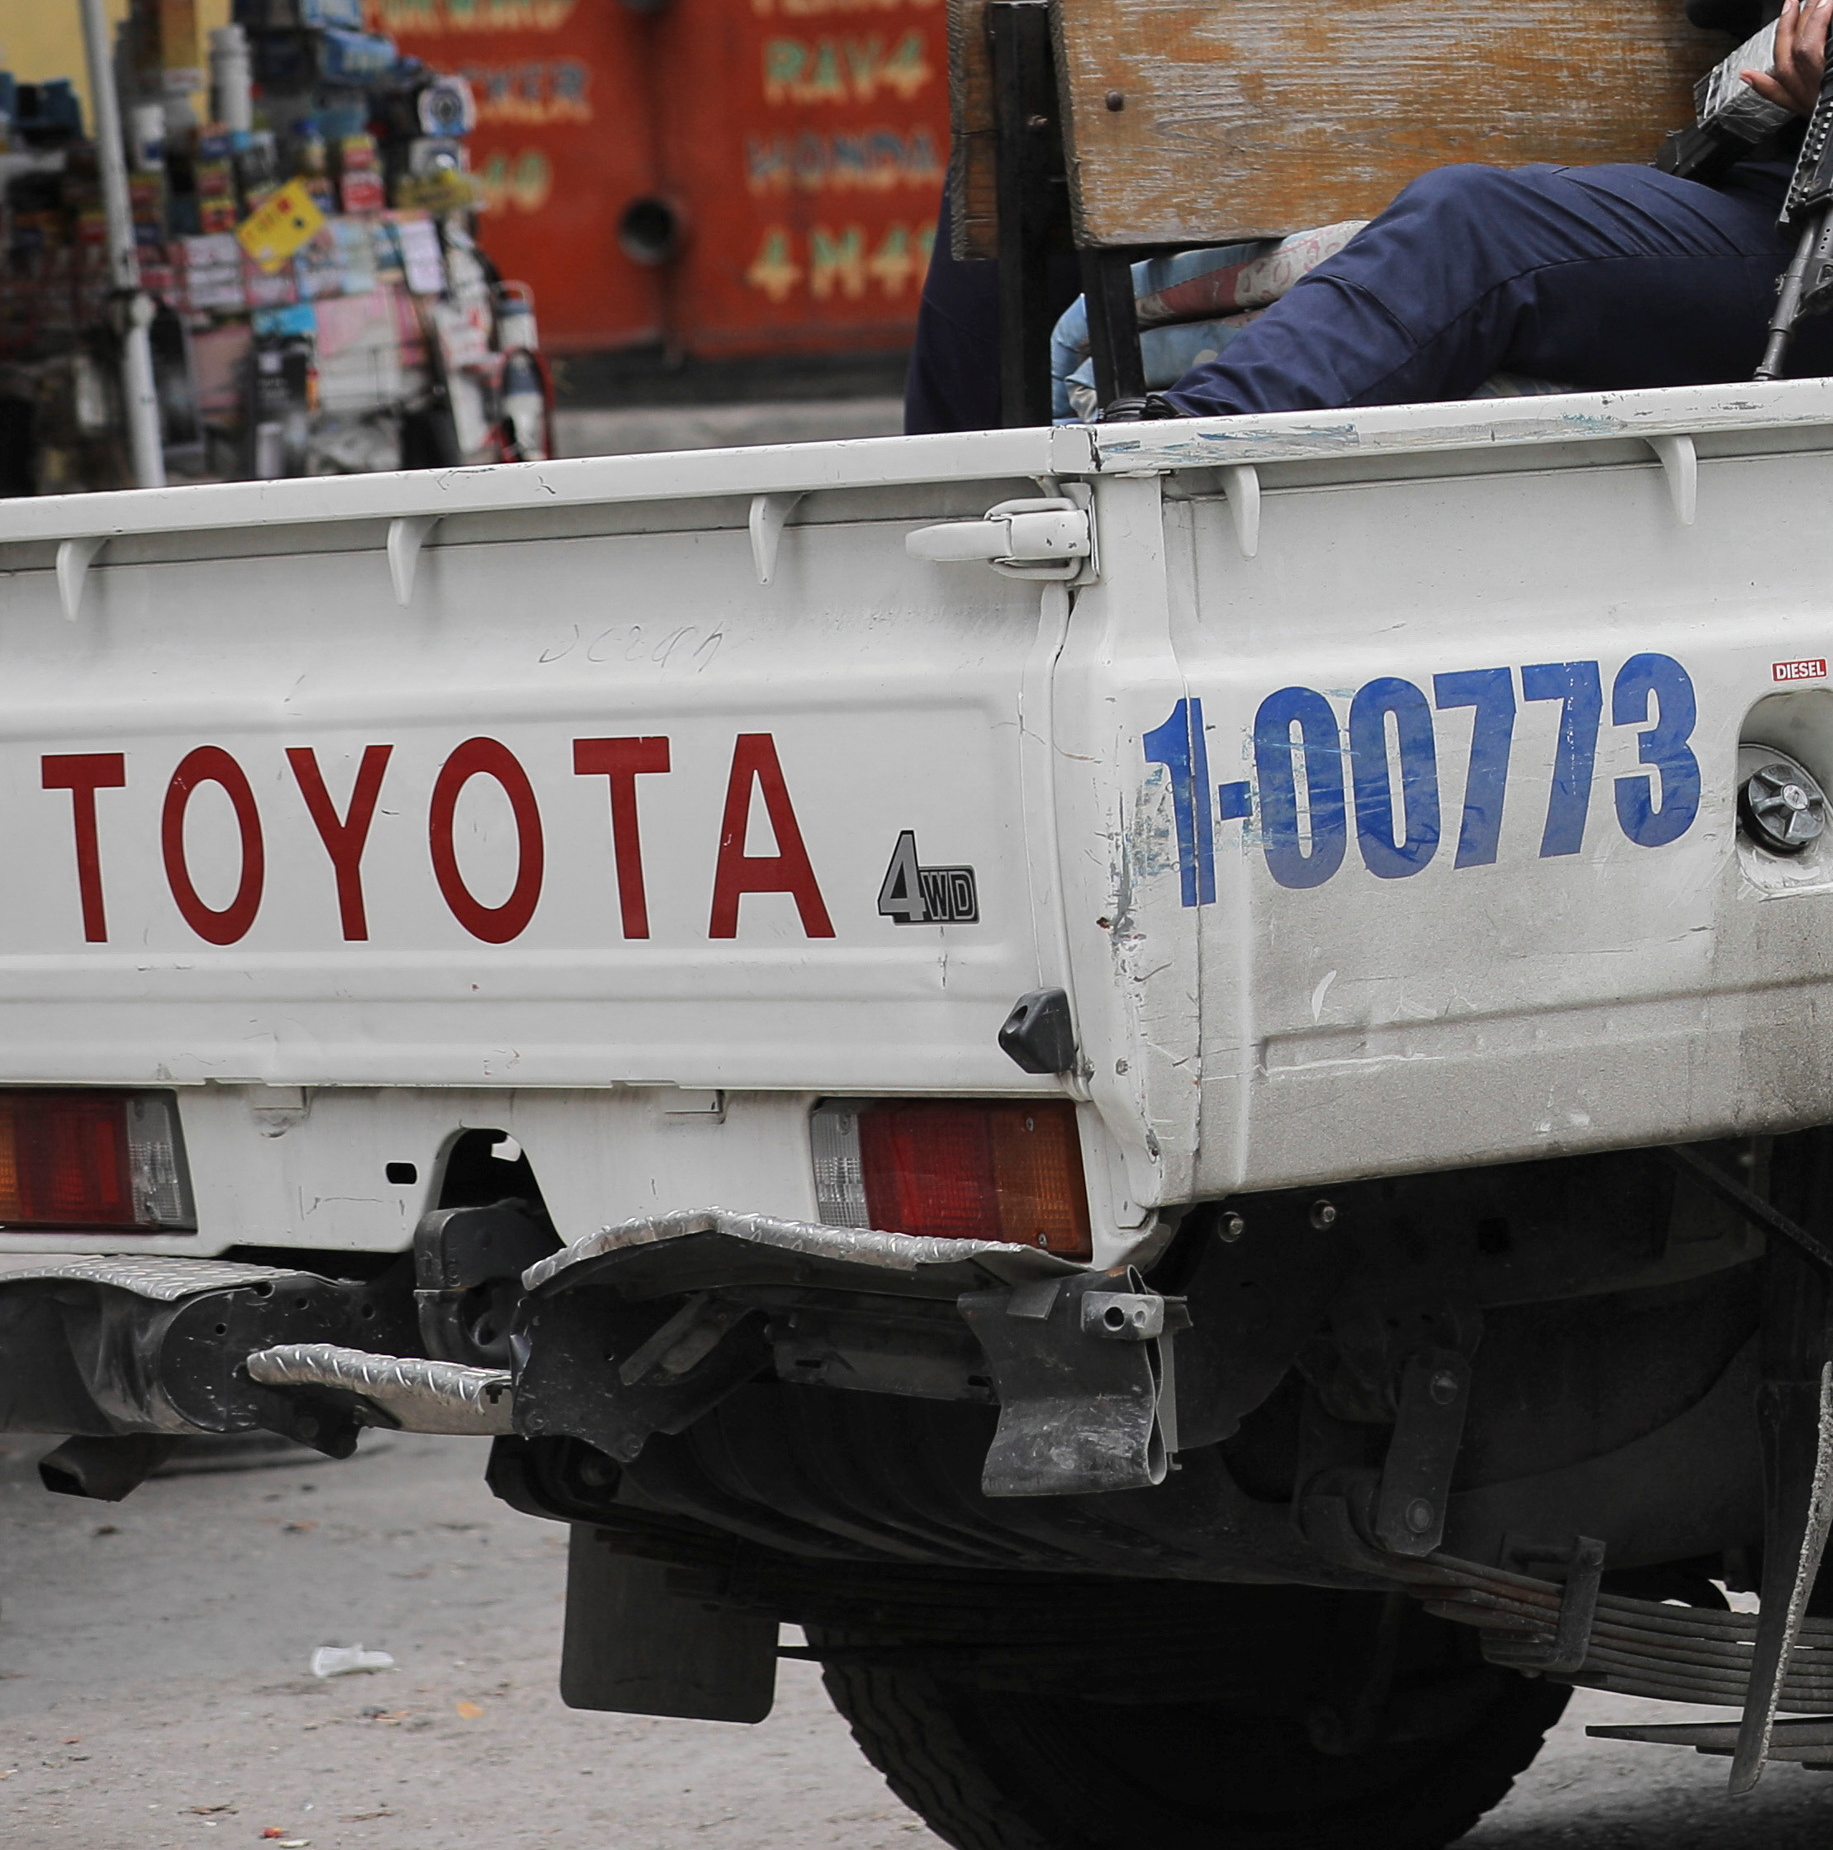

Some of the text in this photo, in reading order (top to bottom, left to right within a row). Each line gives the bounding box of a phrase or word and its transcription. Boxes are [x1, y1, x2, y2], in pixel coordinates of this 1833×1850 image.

[763, 32, 931, 104] RAV4
[1776, 661, 1826, 680] DIESEL
[1141, 652, 1703, 909] 1-00773
[40, 732, 838, 947] TOYOTA
[877, 830, 980, 926] 4WD
